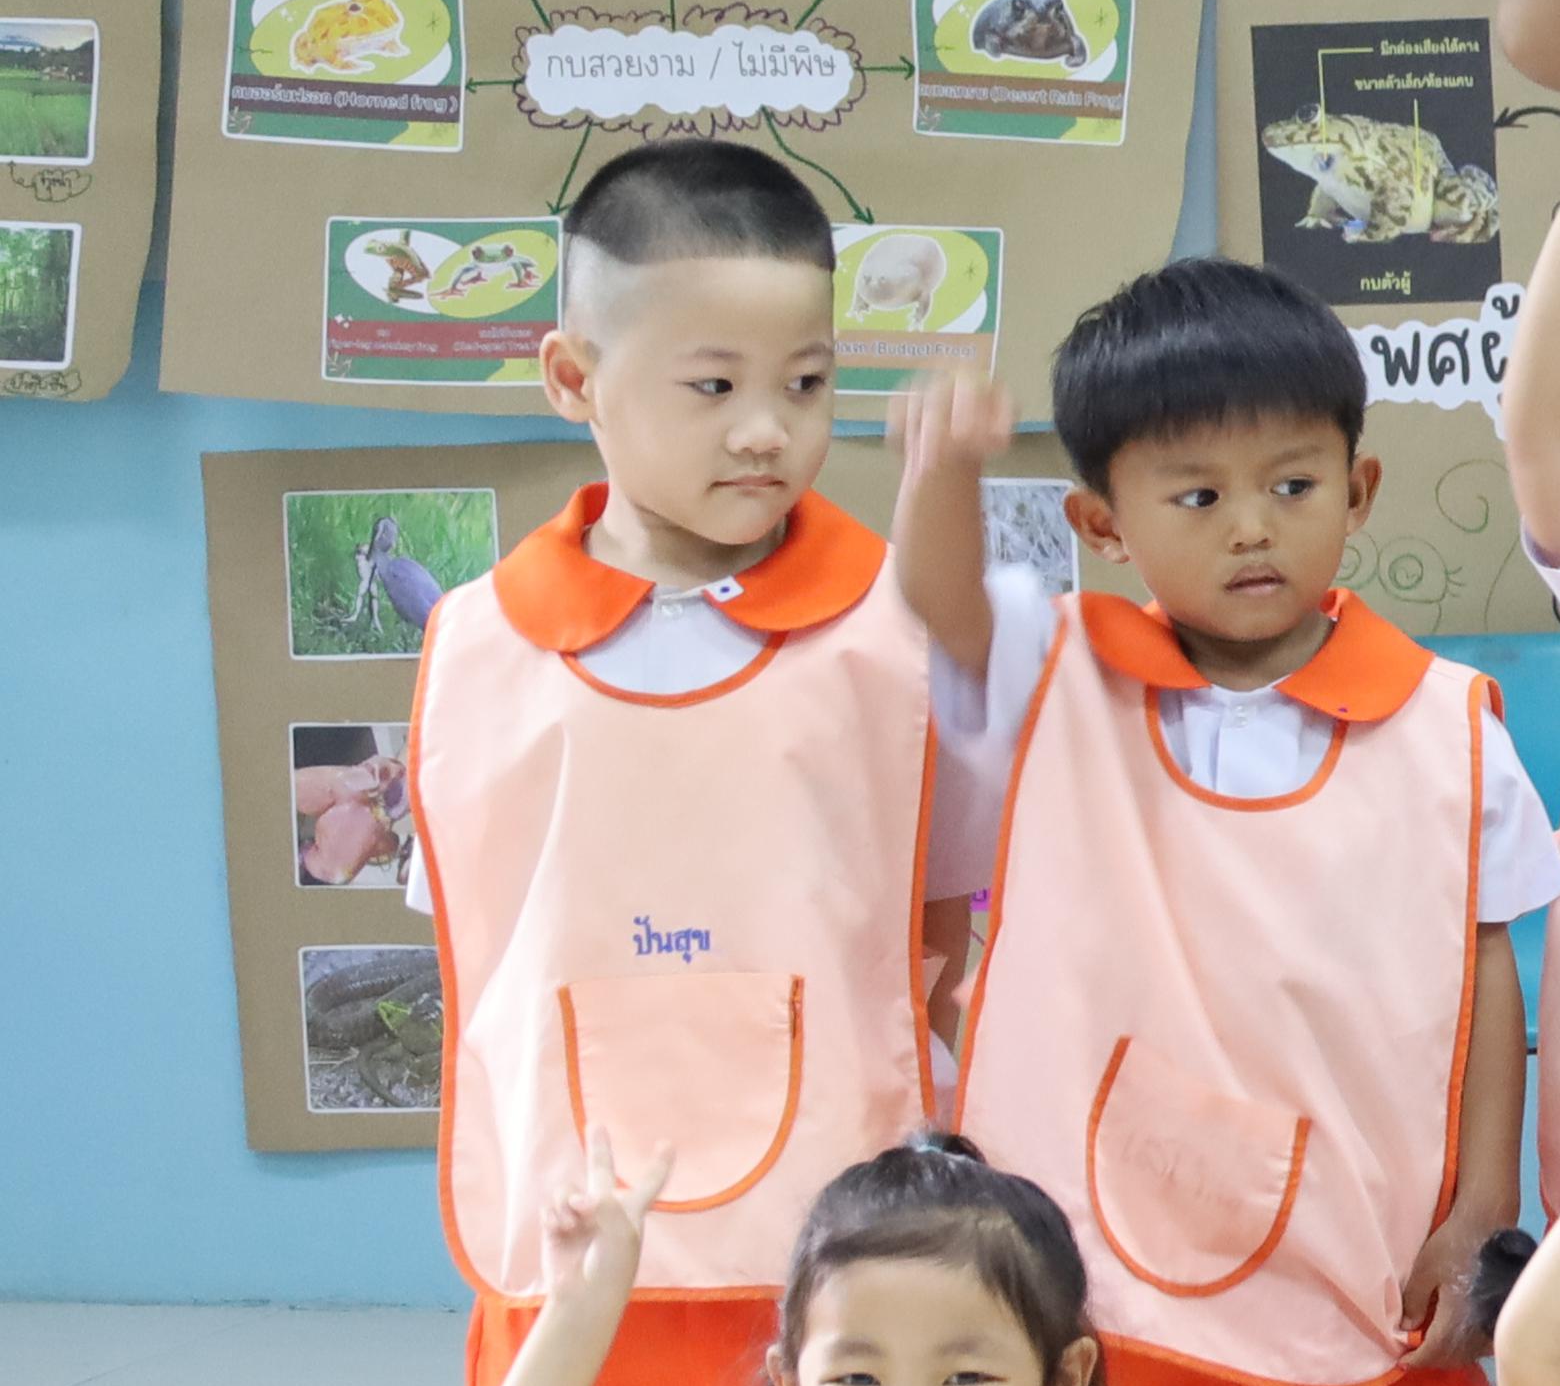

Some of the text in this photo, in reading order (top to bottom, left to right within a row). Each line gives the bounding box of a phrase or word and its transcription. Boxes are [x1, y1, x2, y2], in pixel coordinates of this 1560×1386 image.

[546, 53, 695, 79] กบสวยงาม
[732, 40, 837, 78] ไม่มีพิษ
[1359, 269, 1412, 296] กบตัวผู้
[632, 915, 711, 964] ปันสุข
